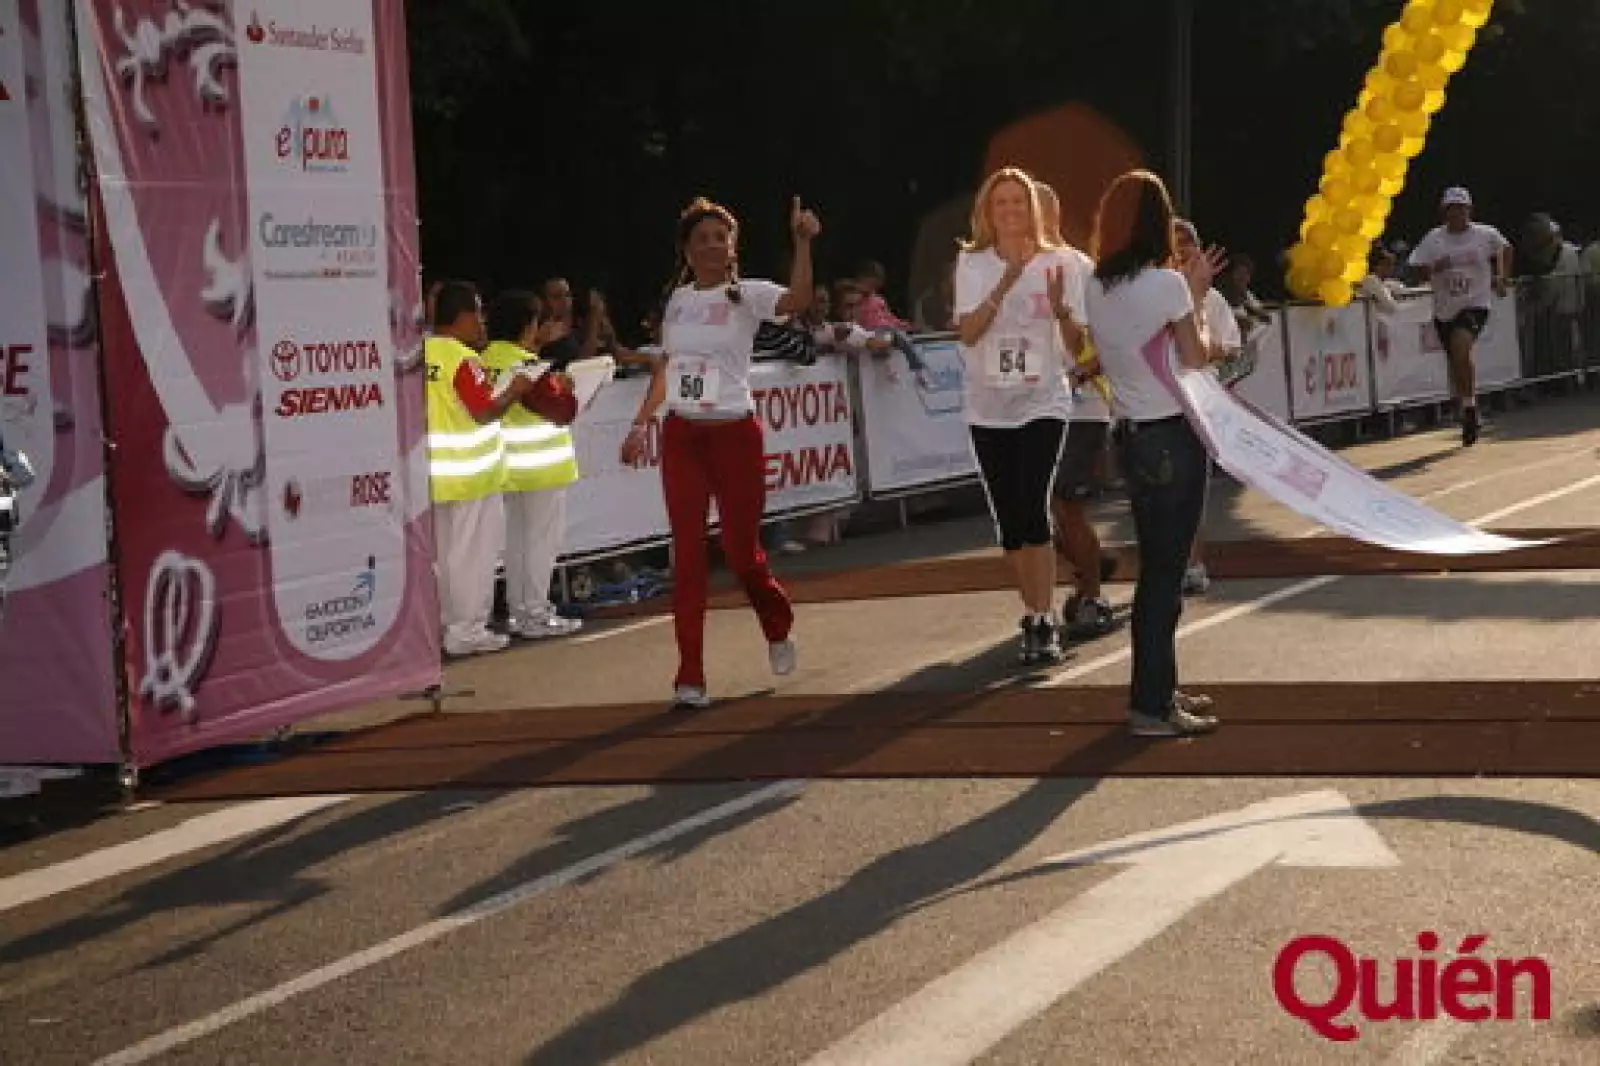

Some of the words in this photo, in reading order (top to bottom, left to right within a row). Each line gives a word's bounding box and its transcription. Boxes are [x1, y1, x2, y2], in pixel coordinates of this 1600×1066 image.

[0, 343, 33, 395] E
[302, 340, 382, 374] TOYOTA
[275, 383, 384, 417] SIENNA
[752, 382, 848, 431] TOYOTA
[763, 443, 850, 492] ENNA
